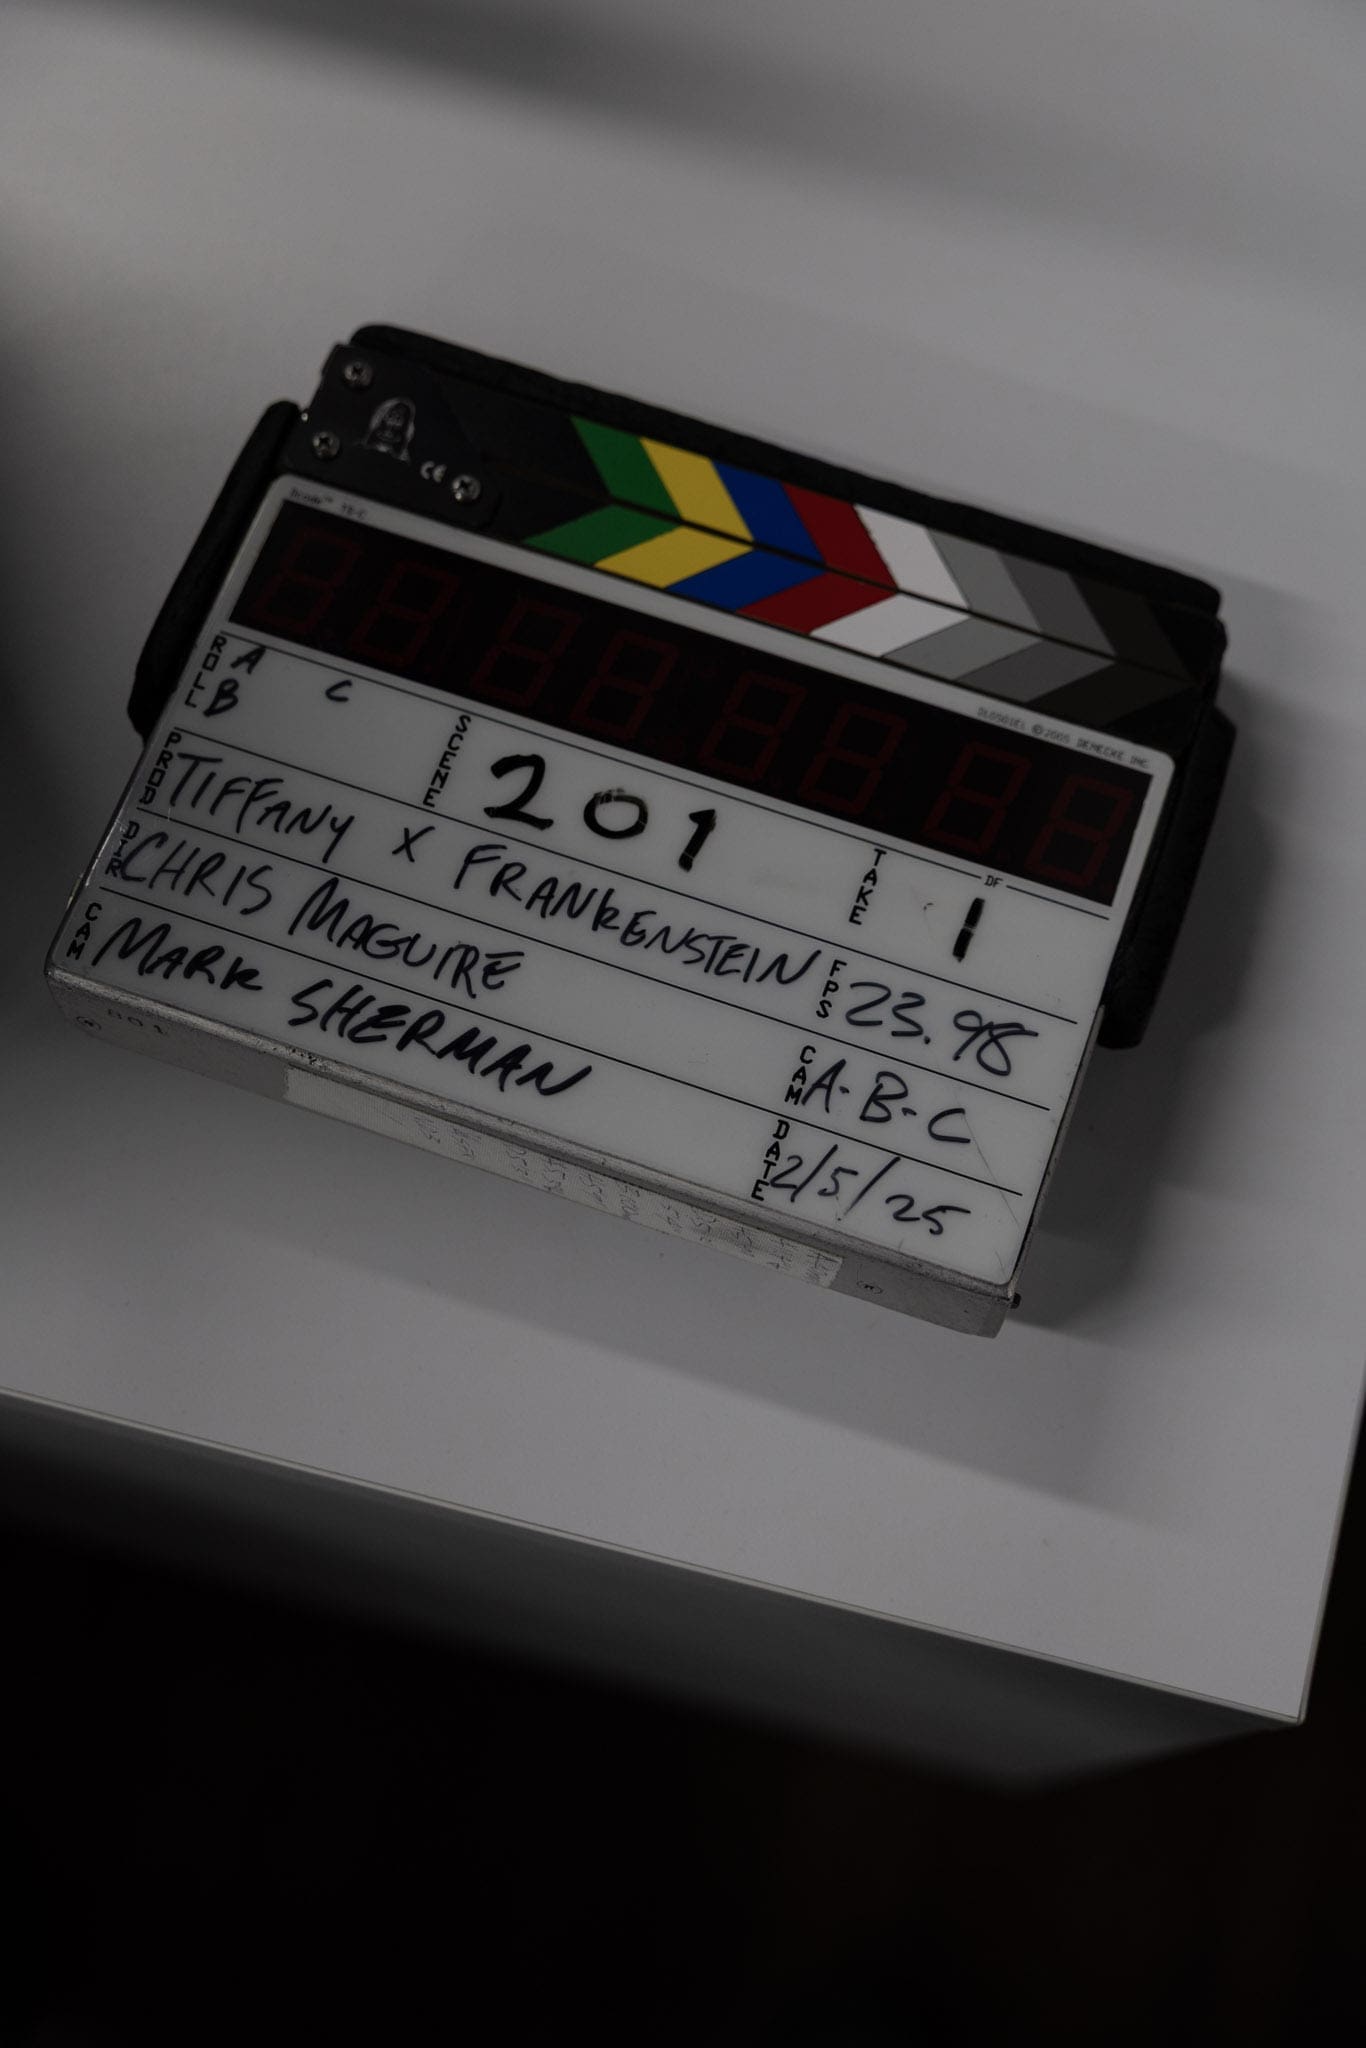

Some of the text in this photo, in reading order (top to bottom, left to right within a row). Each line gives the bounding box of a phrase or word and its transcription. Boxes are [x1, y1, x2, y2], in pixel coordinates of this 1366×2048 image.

[184, 635, 227, 708] ROLL
[230, 645, 267, 674] A
[203, 678, 240, 718] B
[139, 731, 182, 804] PROD
[422, 715, 472, 808] SCENE
[177, 752, 355, 864] TIFFANY
[104, 820, 140, 878] DIR
[984, 874, 1004, 889] DF
[119, 831, 525, 1000] CHRIS MAGUIRE
[848, 848, 887, 926] TAKE
[65, 902, 102, 961] CAM
[815, 959, 847, 1020] FPS
[288, 978, 593, 1097] SHERMAN
[845, 981, 1039, 1077] 23.98
[784, 1045, 816, 1106] CAM
[750, 1119, 790, 1201] DATE
[768, 1144, 971, 1235] 2/5/25
